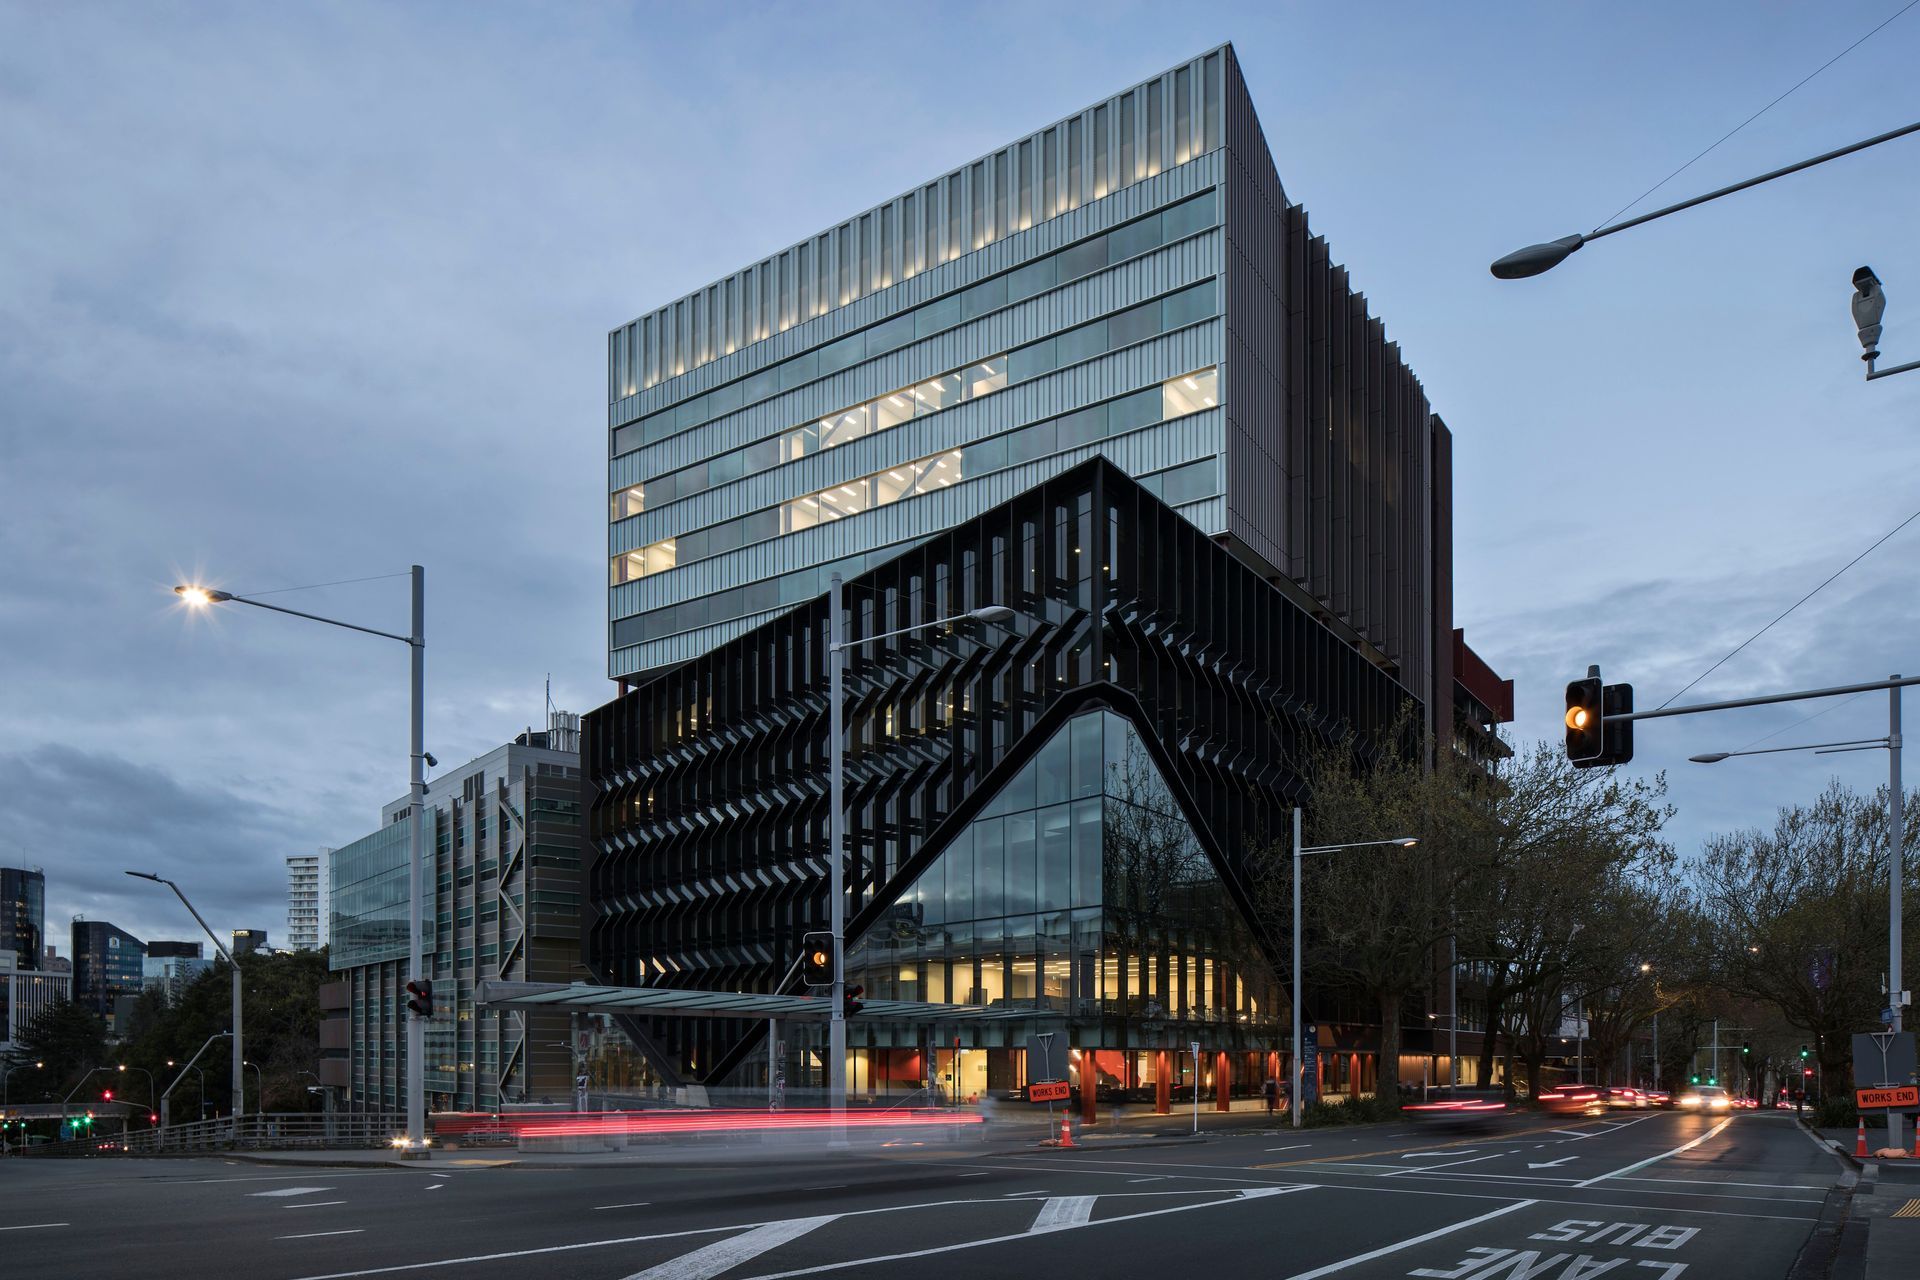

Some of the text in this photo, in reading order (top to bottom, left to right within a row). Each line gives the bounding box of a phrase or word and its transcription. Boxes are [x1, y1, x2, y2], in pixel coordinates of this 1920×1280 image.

[1032, 1086, 1067, 1097] WORKS END
[1861, 1091, 1914, 1103] WORKS END
[1527, 1219, 1701, 1250] BUS
